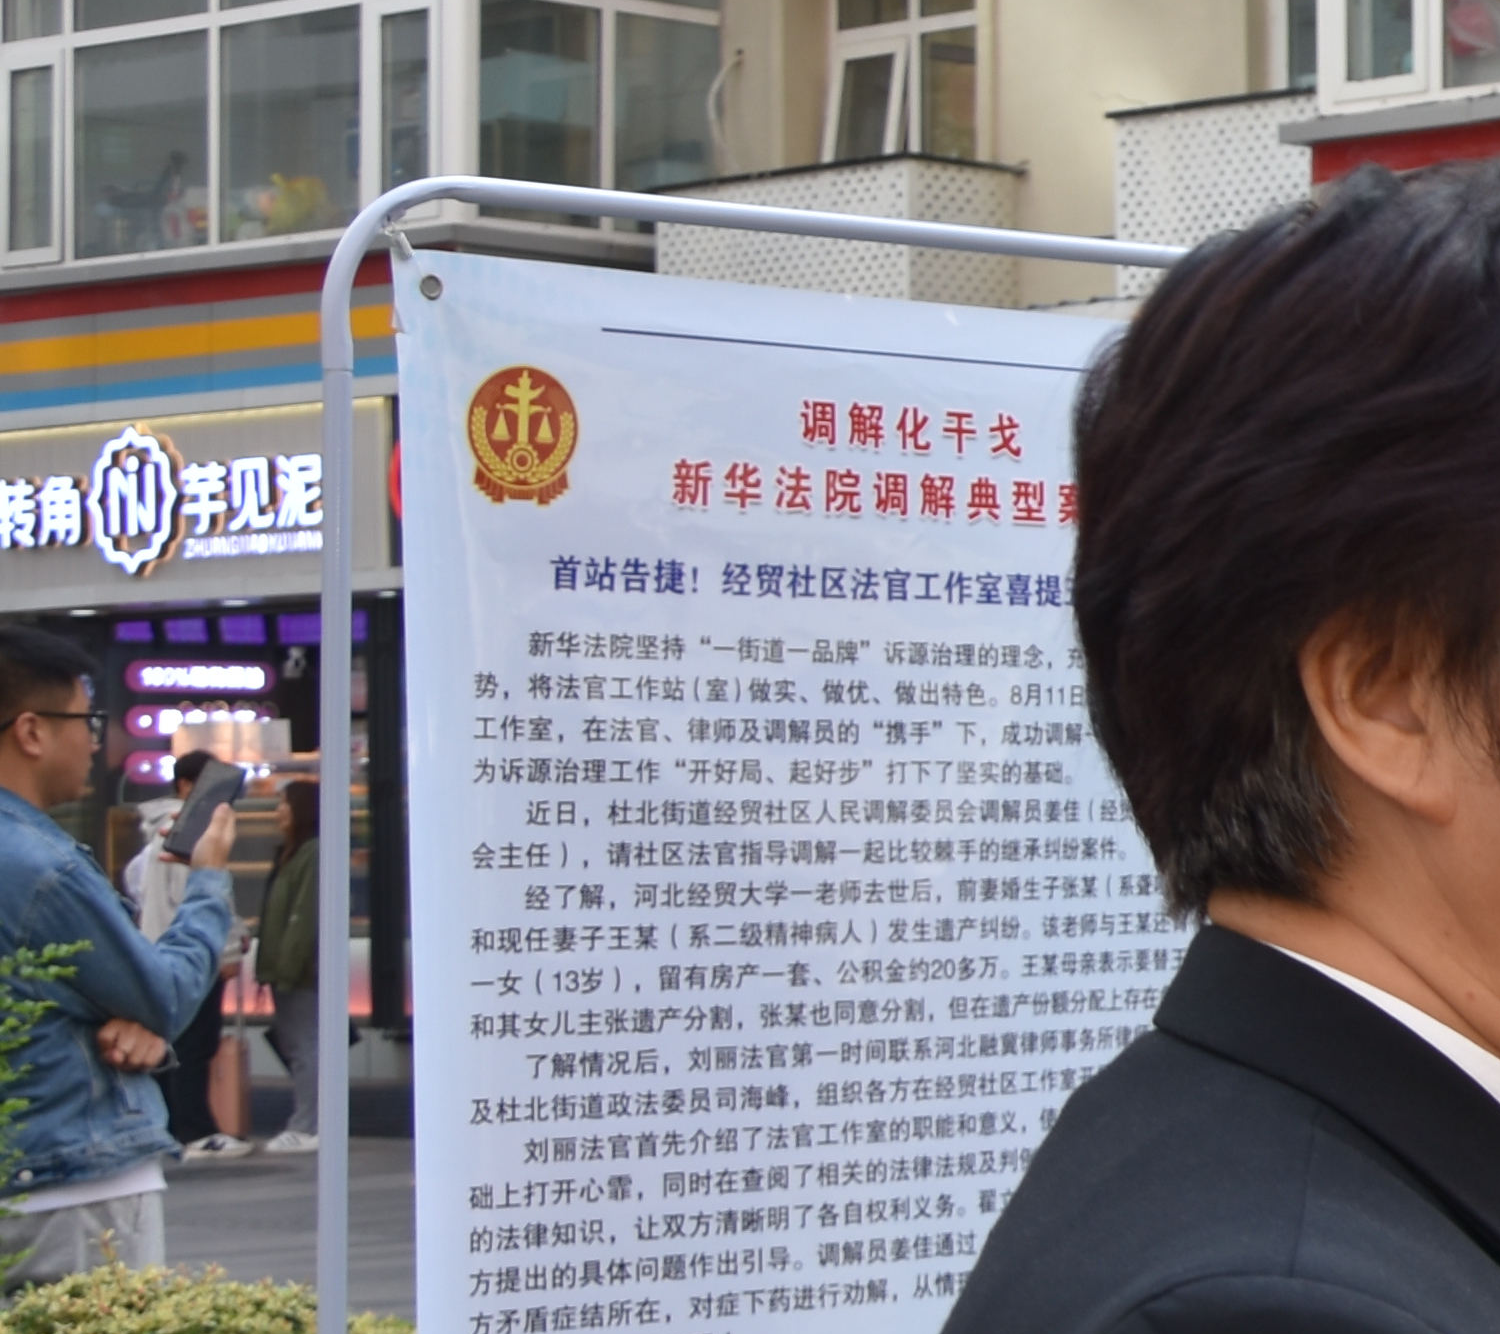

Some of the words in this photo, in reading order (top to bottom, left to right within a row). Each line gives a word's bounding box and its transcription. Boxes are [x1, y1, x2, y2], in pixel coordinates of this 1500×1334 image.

[800, 399, 1023, 458] 调解化干戈
[0, 476, 82, 549] 转角
[181, 453, 323, 534] 芋见泥
[672, 458, 1081, 525] 新华法院调解典型案
[469, 985, 1169, 1040] 和其女儿主张遗产分割，张某也同意分割，但在遗产份额分配上存在
